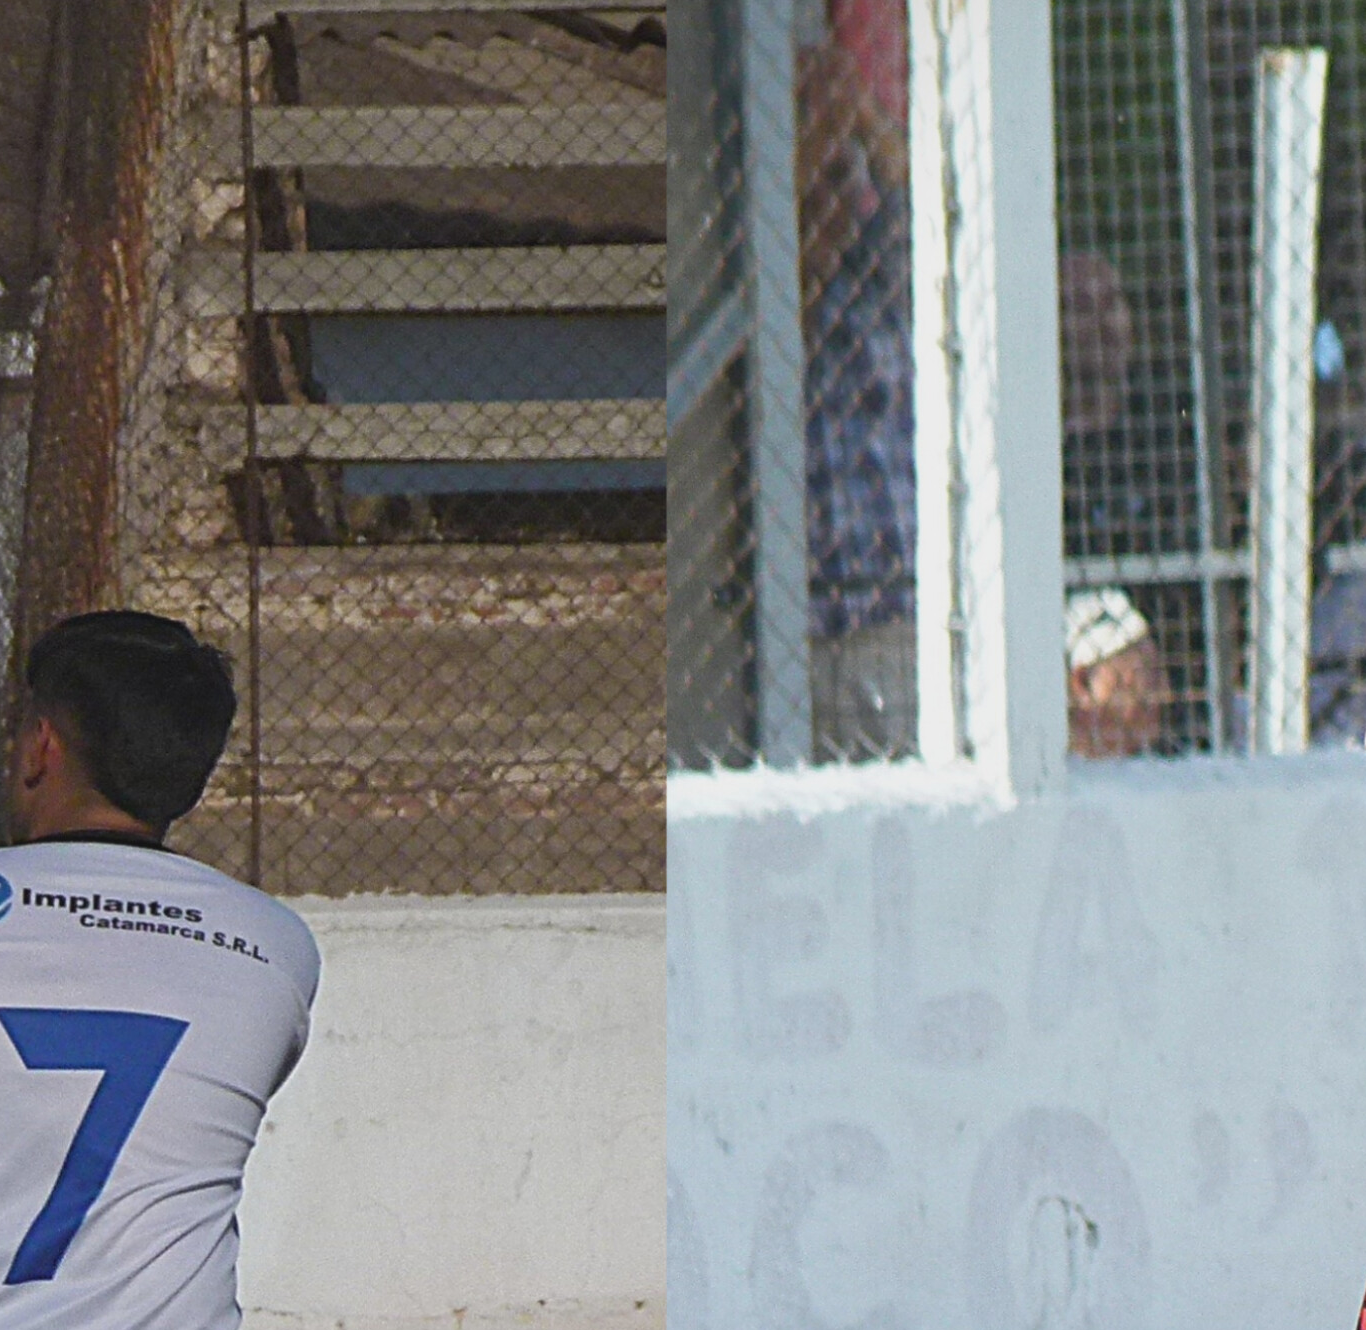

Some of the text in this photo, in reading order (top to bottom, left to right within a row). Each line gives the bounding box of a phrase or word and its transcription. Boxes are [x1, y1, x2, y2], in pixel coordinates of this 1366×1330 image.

[22, 887, 203, 923] Implantes
[79, 913, 269, 964] Catamarca S.R.L.
